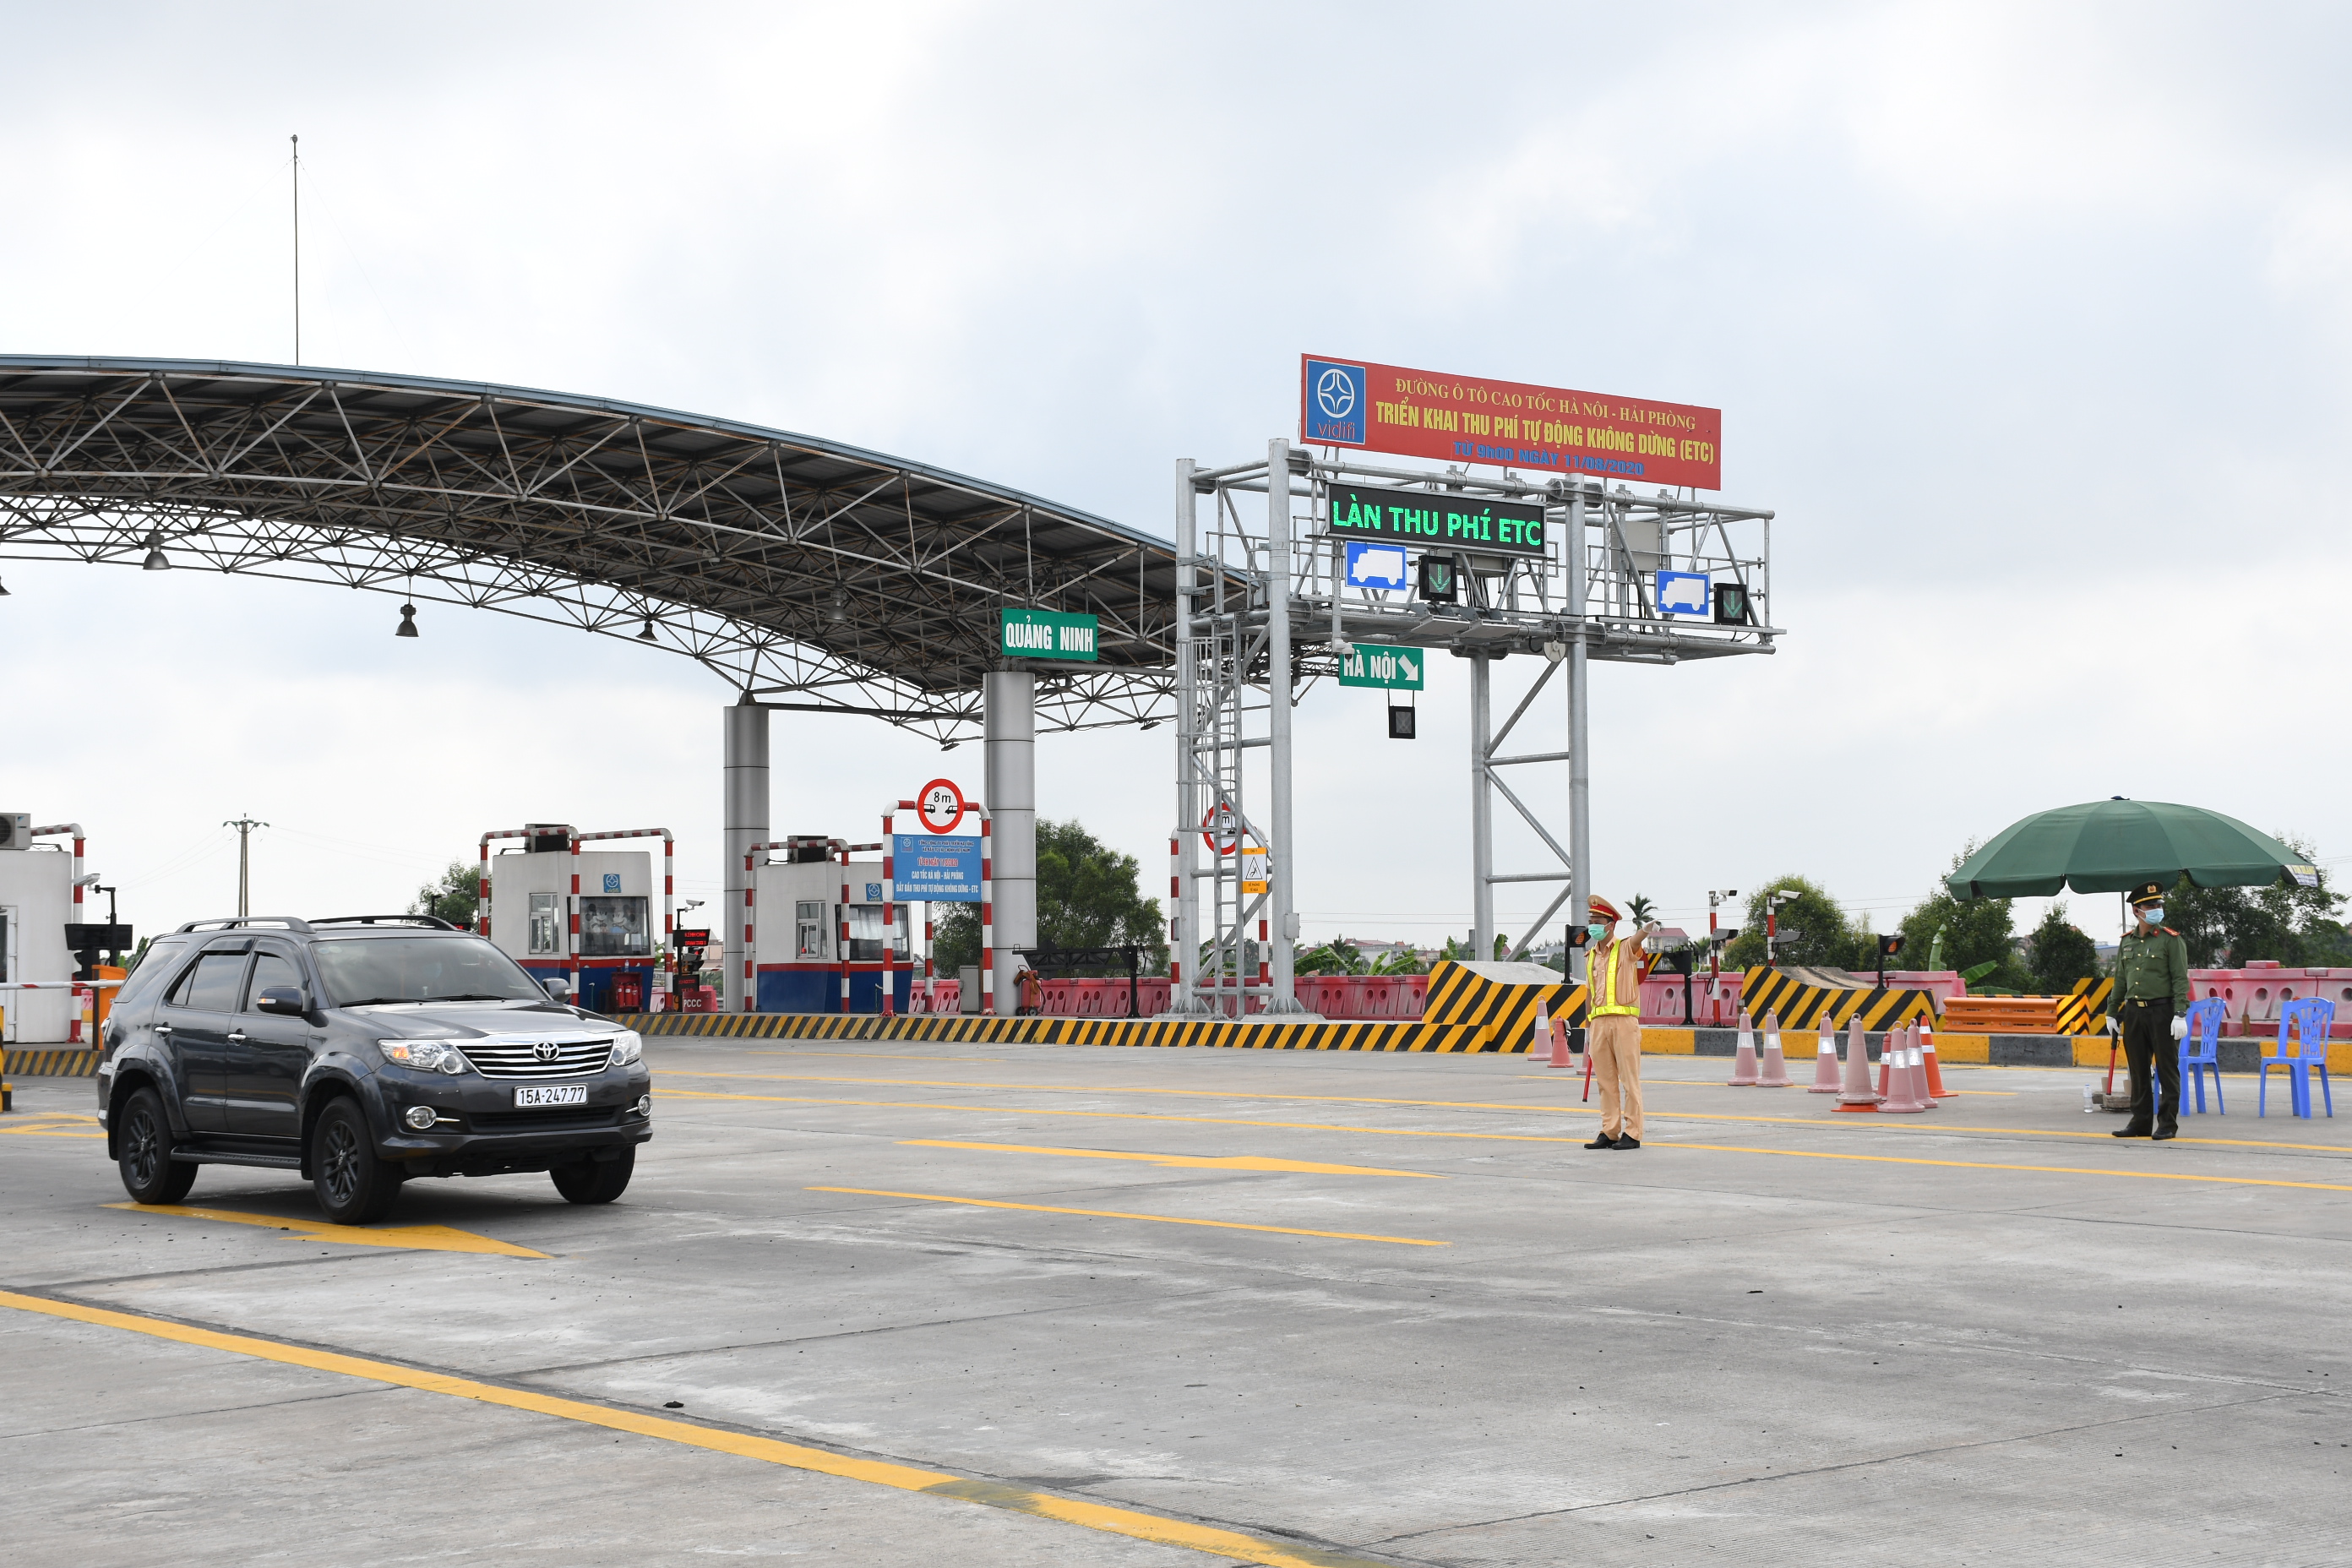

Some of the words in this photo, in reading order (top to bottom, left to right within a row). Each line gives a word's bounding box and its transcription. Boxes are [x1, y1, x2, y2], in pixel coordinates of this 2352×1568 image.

[1396, 378, 1449, 398] ĐƯỜNG
[1453, 384, 1464, 400] Ô
[1467, 386, 1488, 403] TÔ
[1491, 391, 1522, 408] CAO
[1526, 392, 1555, 411] TỐC
[1560, 397, 1579, 415] HÀ
[1583, 400, 1609, 421] NỘI
[1620, 405, 1645, 422] HẢI
[1648, 410, 1696, 430] PHÒNG
[1317, 420, 1355, 439] vidifi
[1375, 396, 1418, 427] TRIỂN
[1424, 407, 1457, 432] KHAI
[1462, 412, 1489, 436] THU
[1494, 415, 1518, 439] PHÍ
[1522, 419, 1542, 445] TỰ
[1544, 420, 1582, 448] ĐỘNG
[1587, 426, 1634, 453] KHÔNG
[1638, 430, 1675, 458] DỪNG
[1680, 439, 1714, 465] (ETC)
[1453, 439, 1474, 456] TỪ
[1477, 444, 1514, 461] 9h00
[1519, 446, 1559, 466] NGÀY
[1564, 454, 1644, 476] 11/08/2020
[1333, 493, 1381, 530] LÀN
[1388, 506, 1439, 536] THU
[1447, 508, 1491, 541] PHÍ
[1499, 518, 1541, 546] ETC
[1005, 615, 1053, 650] QUẢNG
[1059, 626, 1093, 652] NINH
[1343, 649, 1365, 678] HÀ
[1370, 651, 1396, 684] NỘI
[683, 999, 702, 1008] PCCC
[520, 1086, 585, 1105] 15A-247.77
